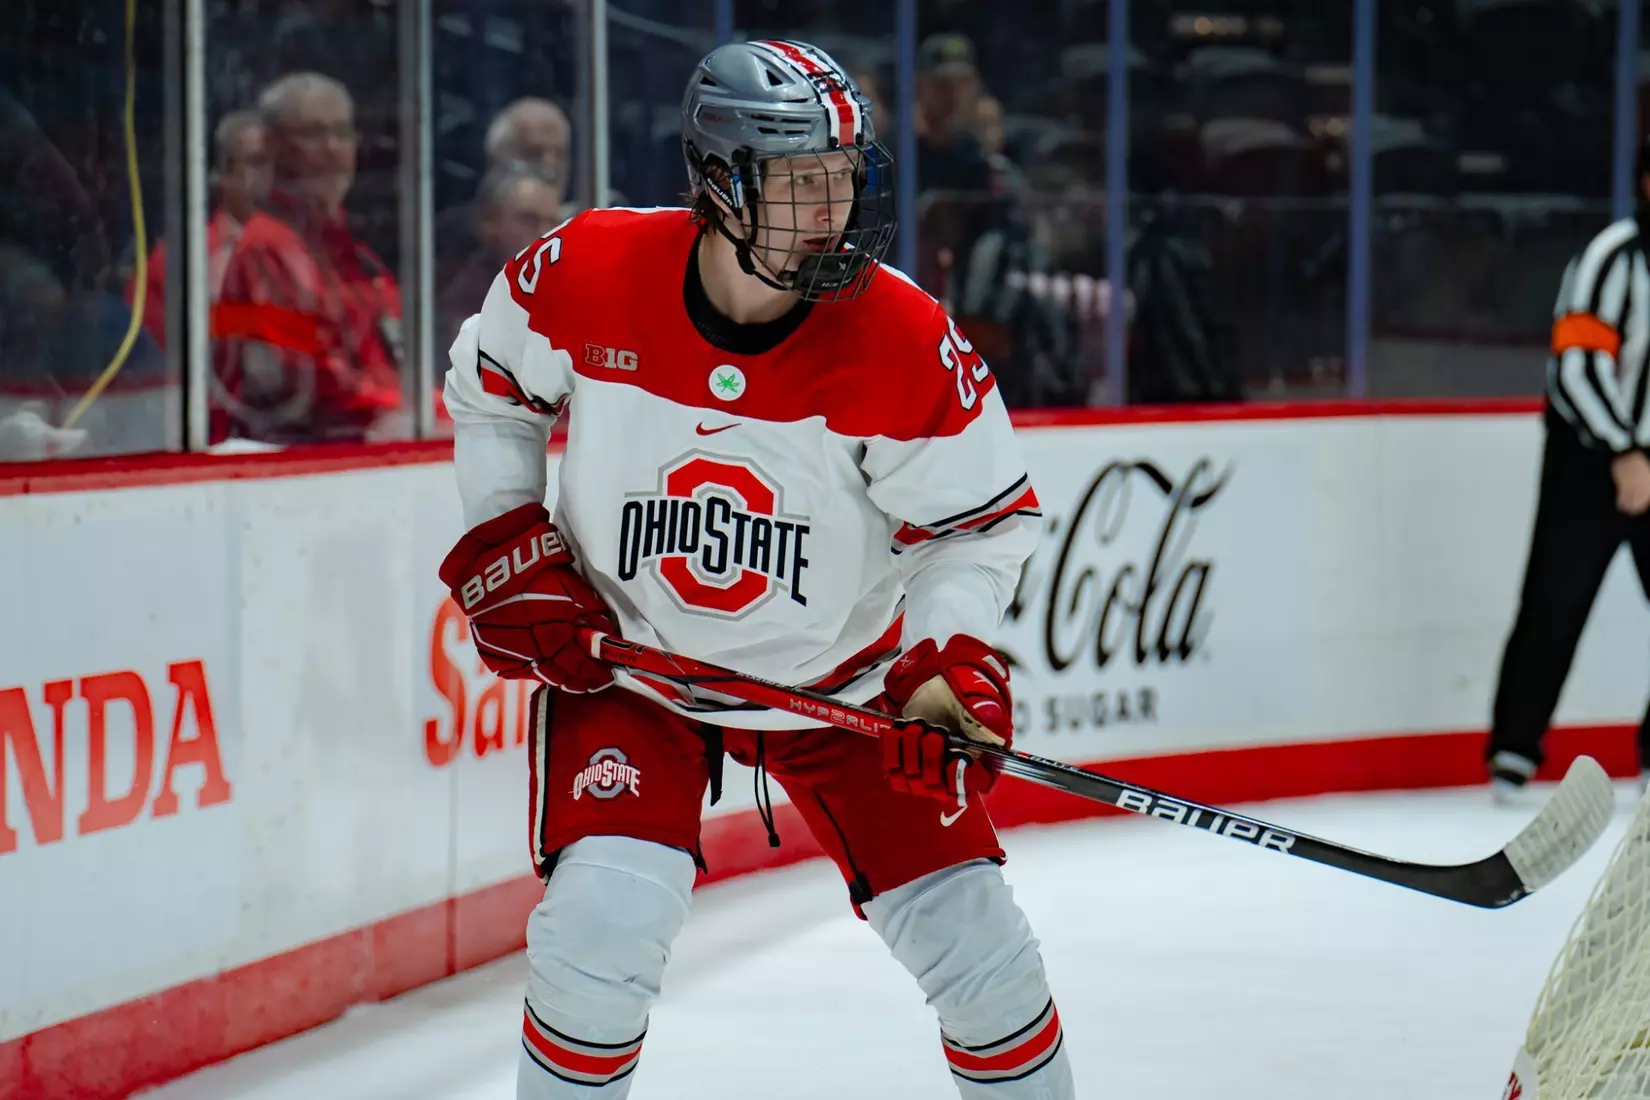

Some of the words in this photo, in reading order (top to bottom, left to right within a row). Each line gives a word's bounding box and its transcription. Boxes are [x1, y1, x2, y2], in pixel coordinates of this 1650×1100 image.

[461, 530, 567, 601] BAUE
[1043, 685, 1159, 736] SUGAR
[0, 660, 232, 855] NDA
